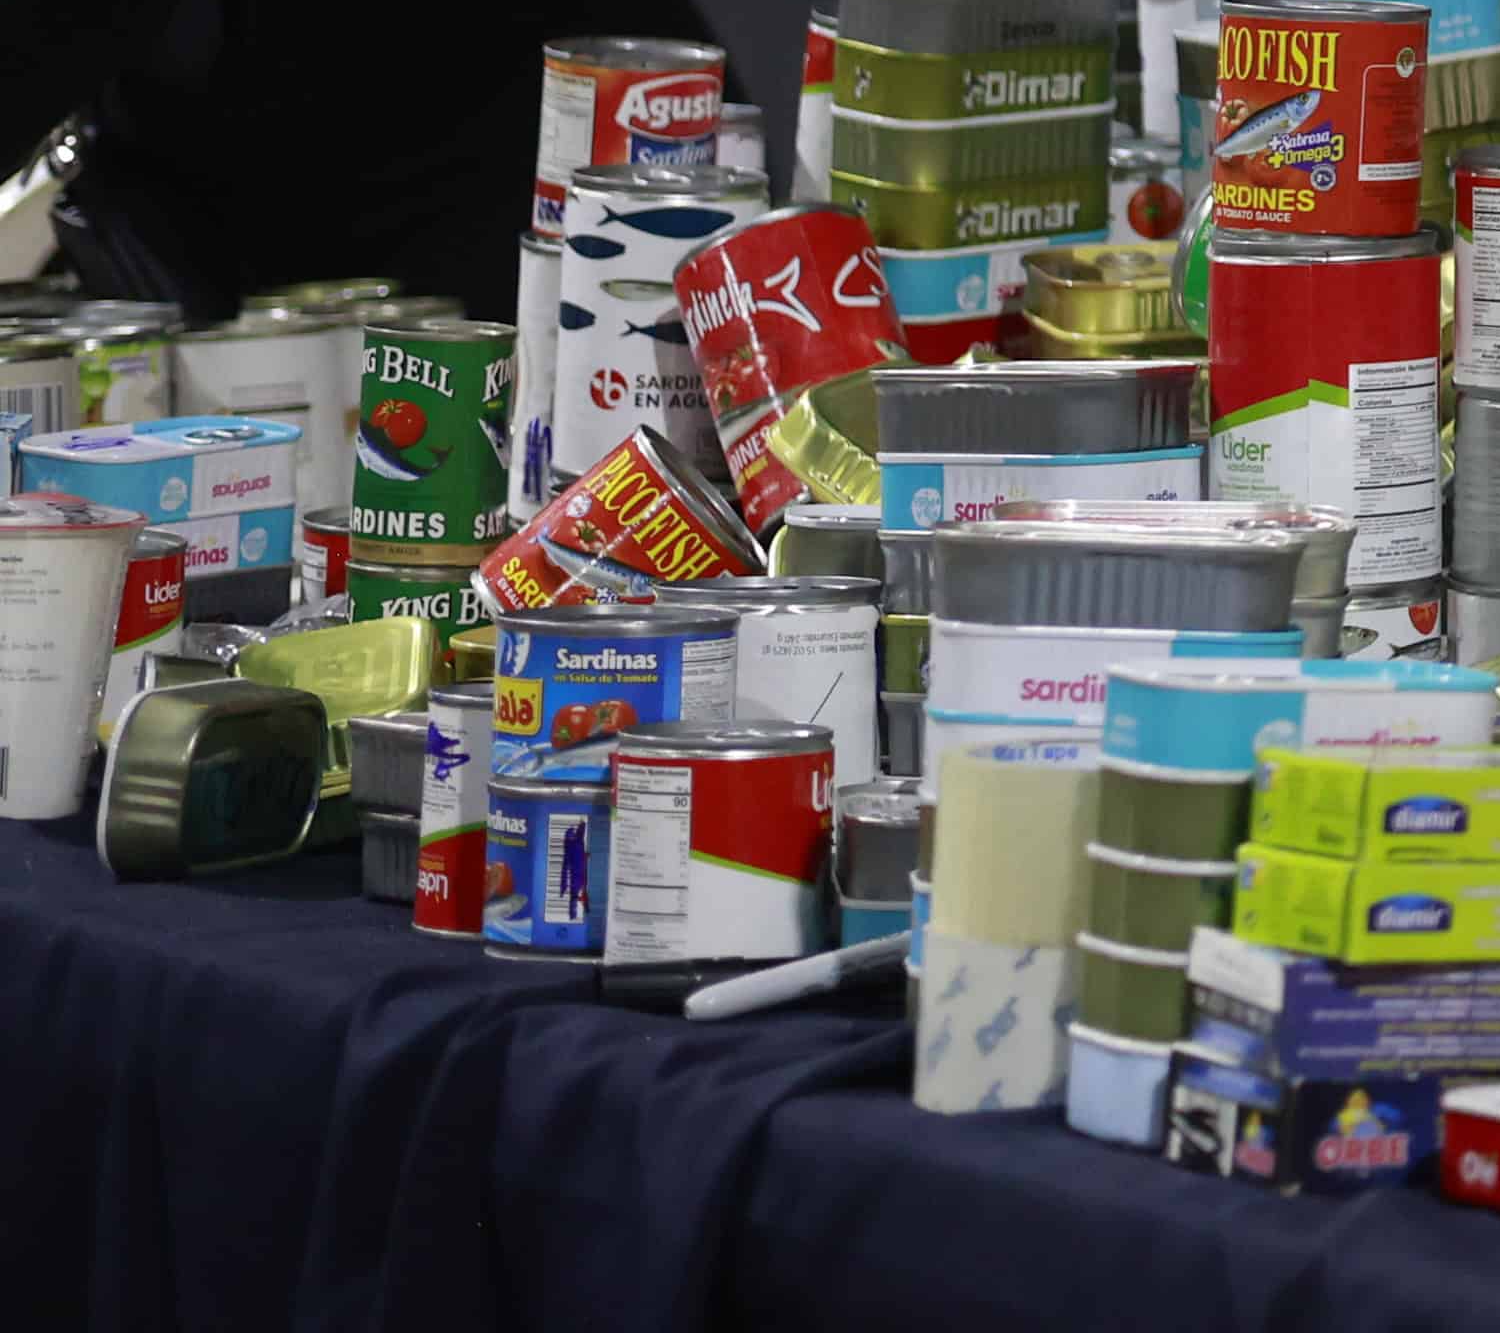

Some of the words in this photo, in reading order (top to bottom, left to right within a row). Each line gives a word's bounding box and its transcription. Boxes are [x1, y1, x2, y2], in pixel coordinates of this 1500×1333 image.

[1255, 28, 1341, 93] FISH
[984, 70, 1087, 107] Dimar
[978, 200, 1081, 237] Dimar
[1256, 211, 1293, 223] SAUCE
[380, 344, 455, 398] BELL
[635, 392, 660, 408] EN
[1222, 435, 1271, 462] Lider
[212, 474, 271, 498] sardinas
[584, 448, 659, 527] PACO
[631, 504, 720, 582] FISH
[556, 647, 658, 671] Sardinas
[616, 673, 658, 683] Tomate
